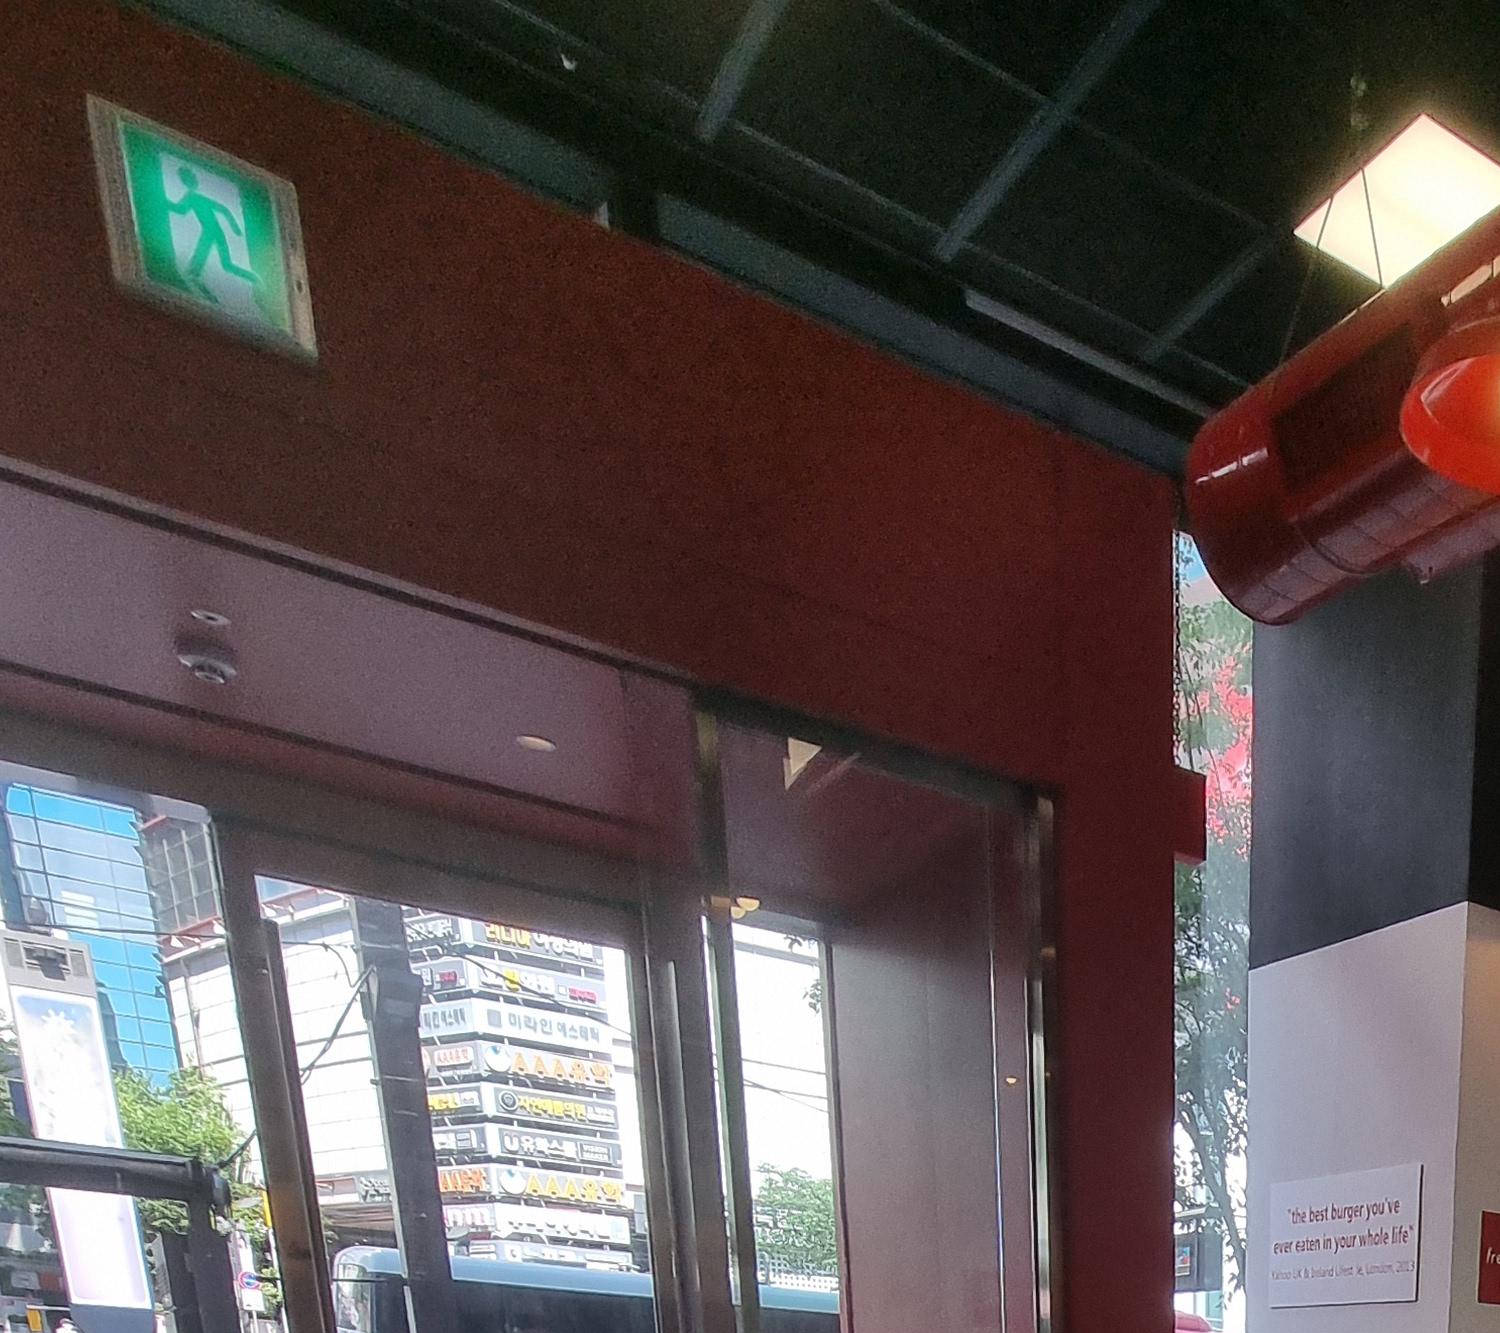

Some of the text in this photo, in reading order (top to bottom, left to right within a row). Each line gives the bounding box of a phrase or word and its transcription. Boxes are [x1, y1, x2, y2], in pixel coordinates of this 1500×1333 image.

[511, 1052, 613, 1086] AAA유학
[526, 1170, 623, 1204] AAA유학
[1309, 1202, 1328, 1223] best
[1331, 1203, 1364, 1224] burger
[1365, 1197, 1400, 1221] you've
[1273, 1240, 1293, 1255] ever
[1295, 1236, 1320, 1252] eaten
[1322, 1232, 1332, 1251] in
[1334, 1234, 1357, 1254] your
[1358, 1226, 1389, 1248] whole
